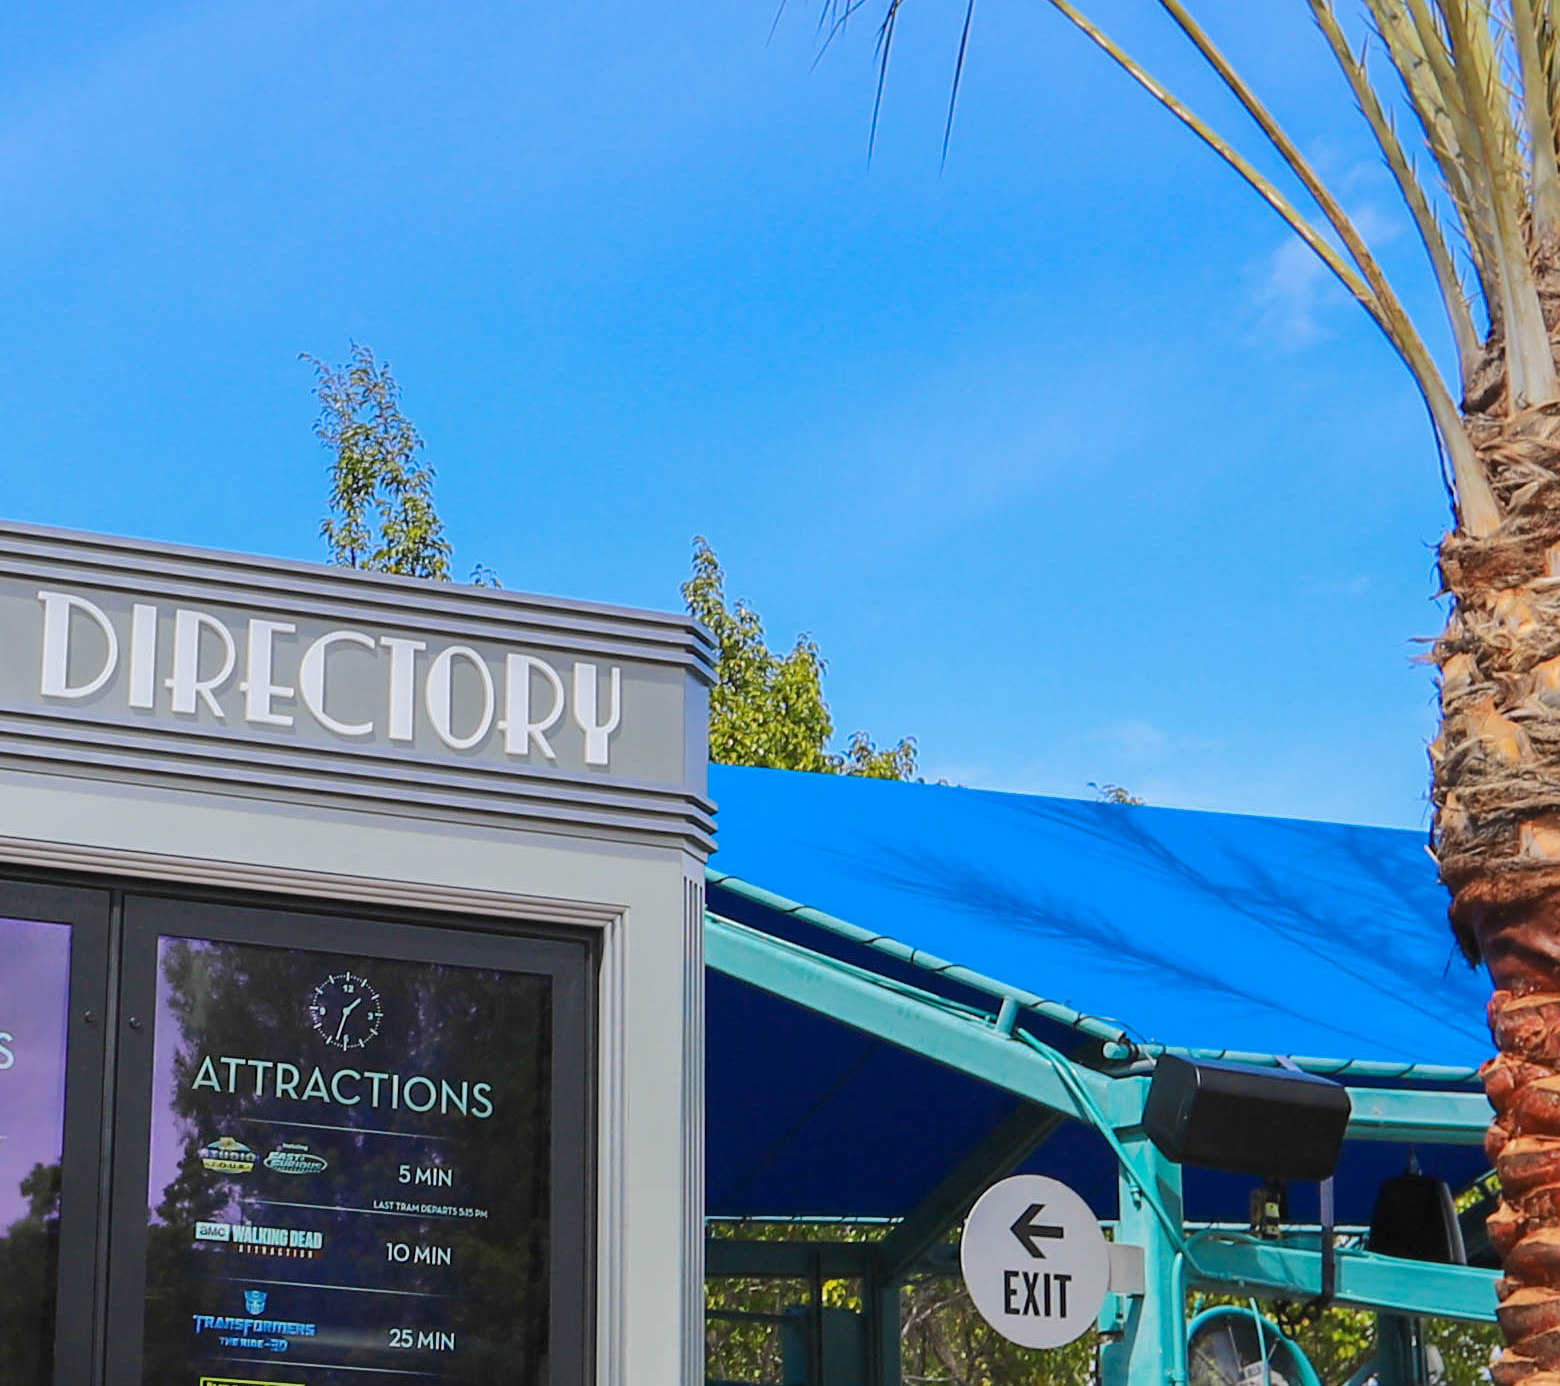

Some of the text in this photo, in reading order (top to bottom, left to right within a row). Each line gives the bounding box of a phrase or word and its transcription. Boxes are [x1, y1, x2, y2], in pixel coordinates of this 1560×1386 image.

[38, 590, 621, 766] DIRECTORY
[342, 984, 354, 993] 12
[367, 1012, 374, 1020] 3
[192, 1054, 495, 1119] ATTRACTIONS
[398, 1164, 453, 1187] 5 MIN
[373, 1200, 394, 1210] LAST
[395, 1201, 420, 1212] TRAM
[420, 1204, 458, 1216] DEPARTS
[475, 1208, 488, 1219] PM
[231, 1224, 288, 1247] WALKING
[289, 1229, 323, 1249] DEAD
[386, 1242, 452, 1266] 10 MIN
[1003, 1270, 1072, 1318] EXIT
[192, 1314, 317, 1337] TRANSFORMERS
[218, 1336, 240, 1346] THE
[388, 1329, 456, 1351] 25 MIN
